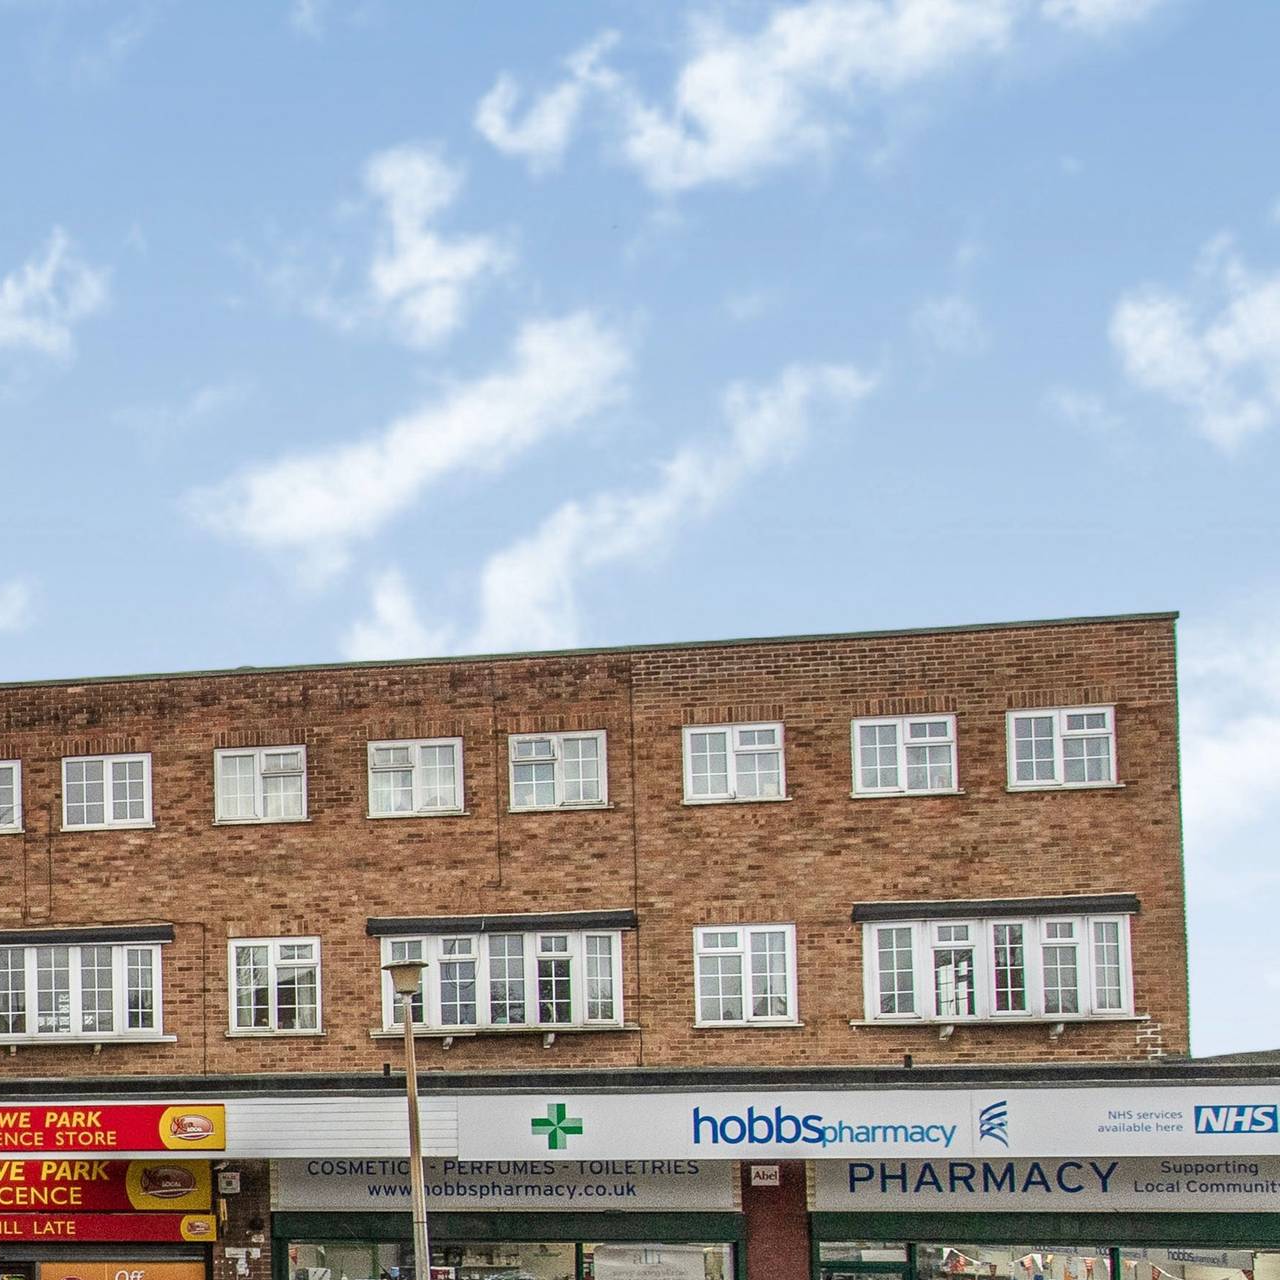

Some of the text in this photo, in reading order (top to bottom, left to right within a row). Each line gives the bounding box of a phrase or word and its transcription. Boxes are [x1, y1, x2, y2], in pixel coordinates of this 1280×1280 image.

[45, 1111, 102, 1128] PARK
[1107, 1110, 1183, 1120] NHS services
[1197, 1107, 1274, 1132] NHS
[1097, 1122, 1183, 1132] available here
[55, 1131, 117, 1146] STORE
[41, 1161, 109, 1181] PARK
[306, 1161, 410, 1176] COSMETIC
[443, 1160, 555, 1175] PERFUMES
[576, 1160, 700, 1175] TOILETRIES
[753, 1170, 778, 1181] Abel
[1160, 1160, 1259, 1176] Supporting
[848, 1161, 1120, 1193] PHARMACY
[368, 1181, 637, 1199] wwwobbspharmacy.co.uk
[1134, 1180, 1280, 1193] Local Communit
[34, 1221, 76, 1235] LATE
